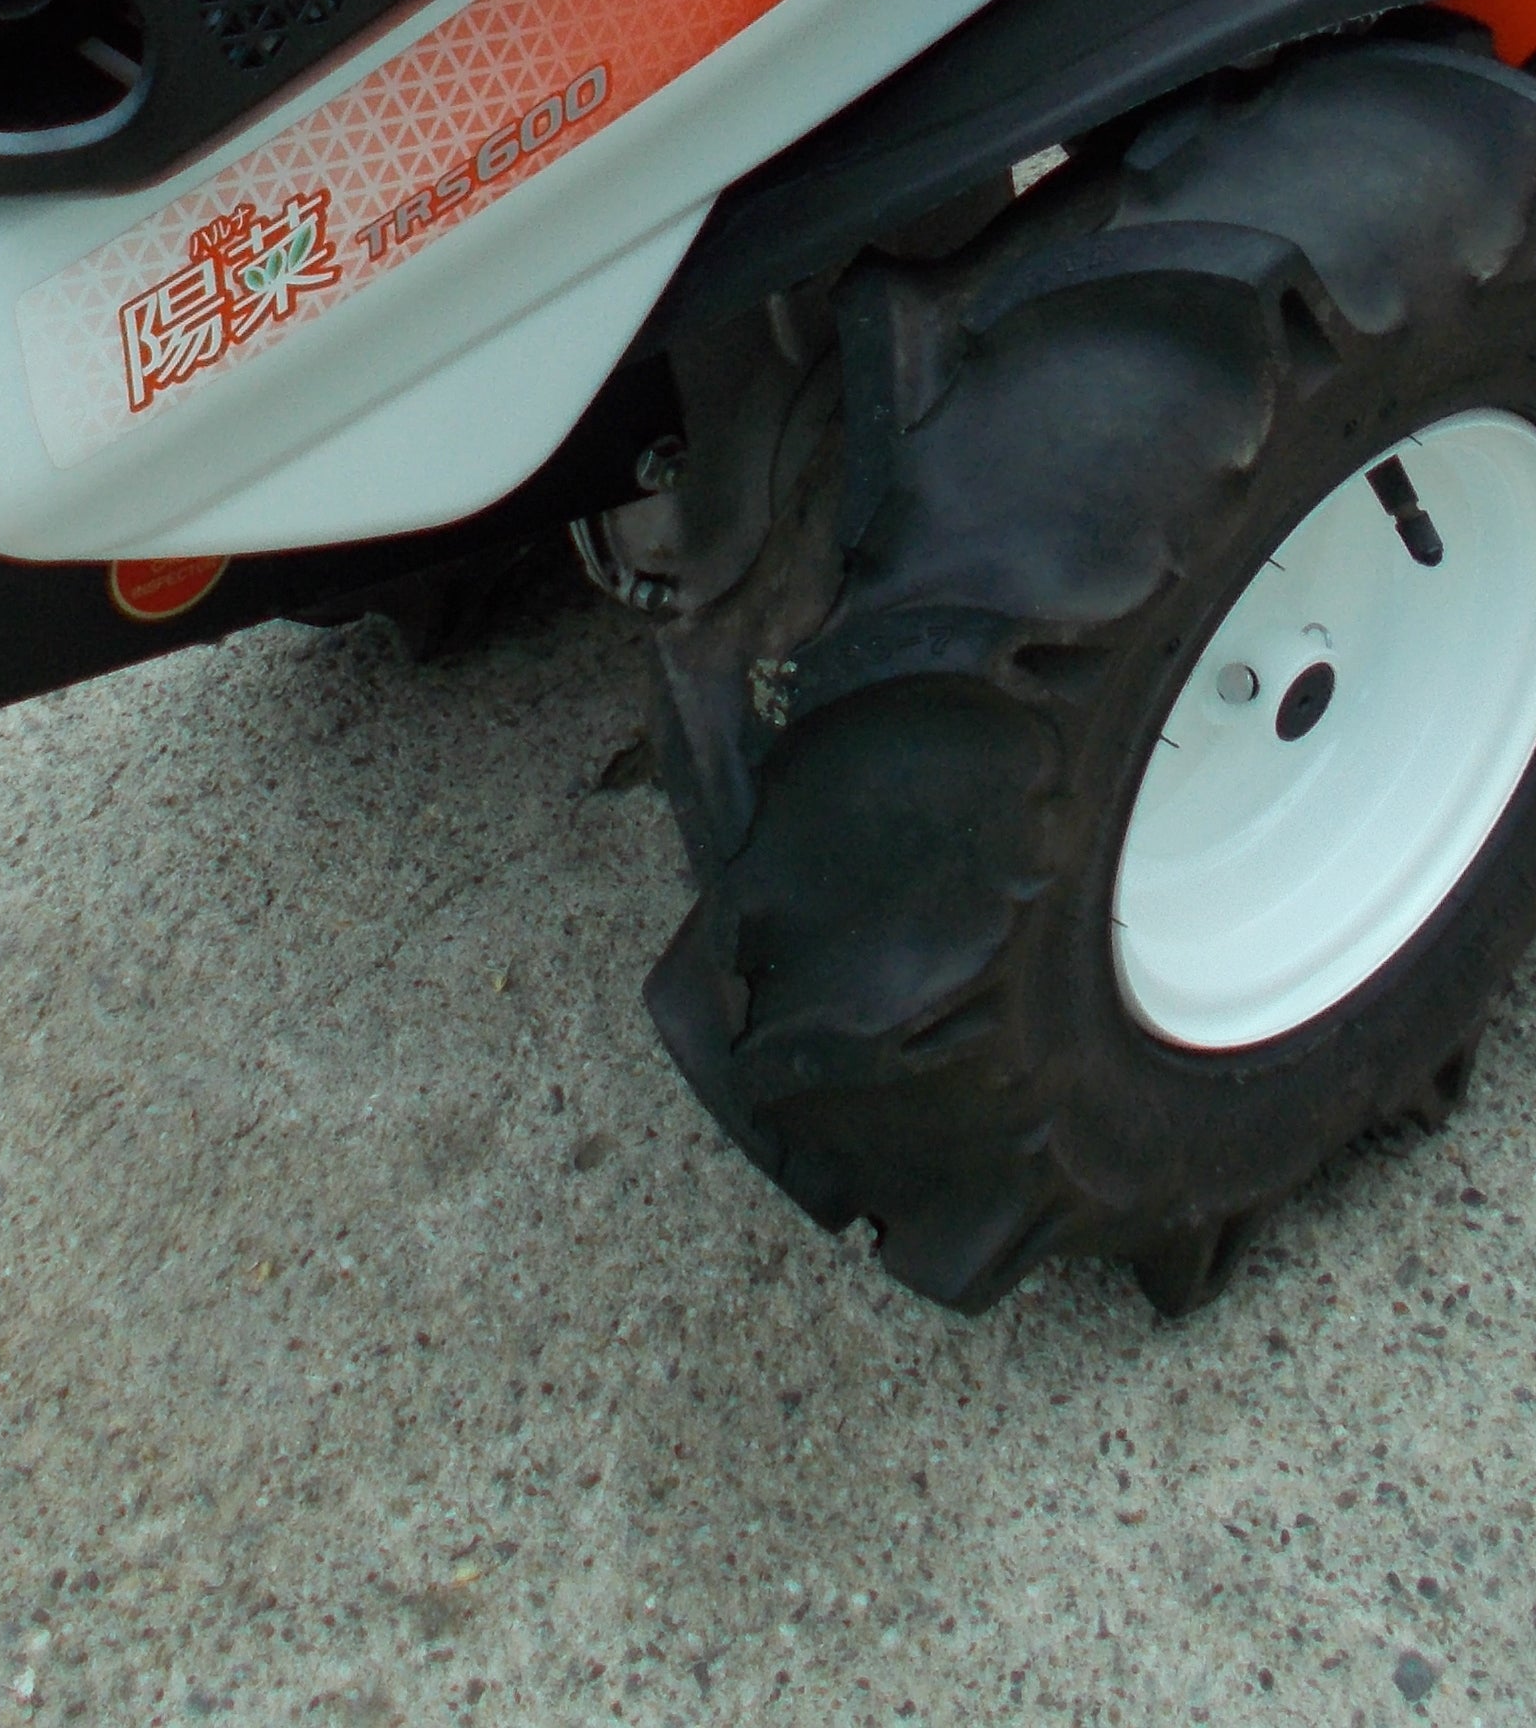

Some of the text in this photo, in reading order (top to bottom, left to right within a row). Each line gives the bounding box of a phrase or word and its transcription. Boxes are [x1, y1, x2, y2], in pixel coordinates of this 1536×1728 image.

[193, 207, 250, 257] ハルナ
[356, 64, 608, 259] TRS600
[122, 193, 337, 407] 陽菜
